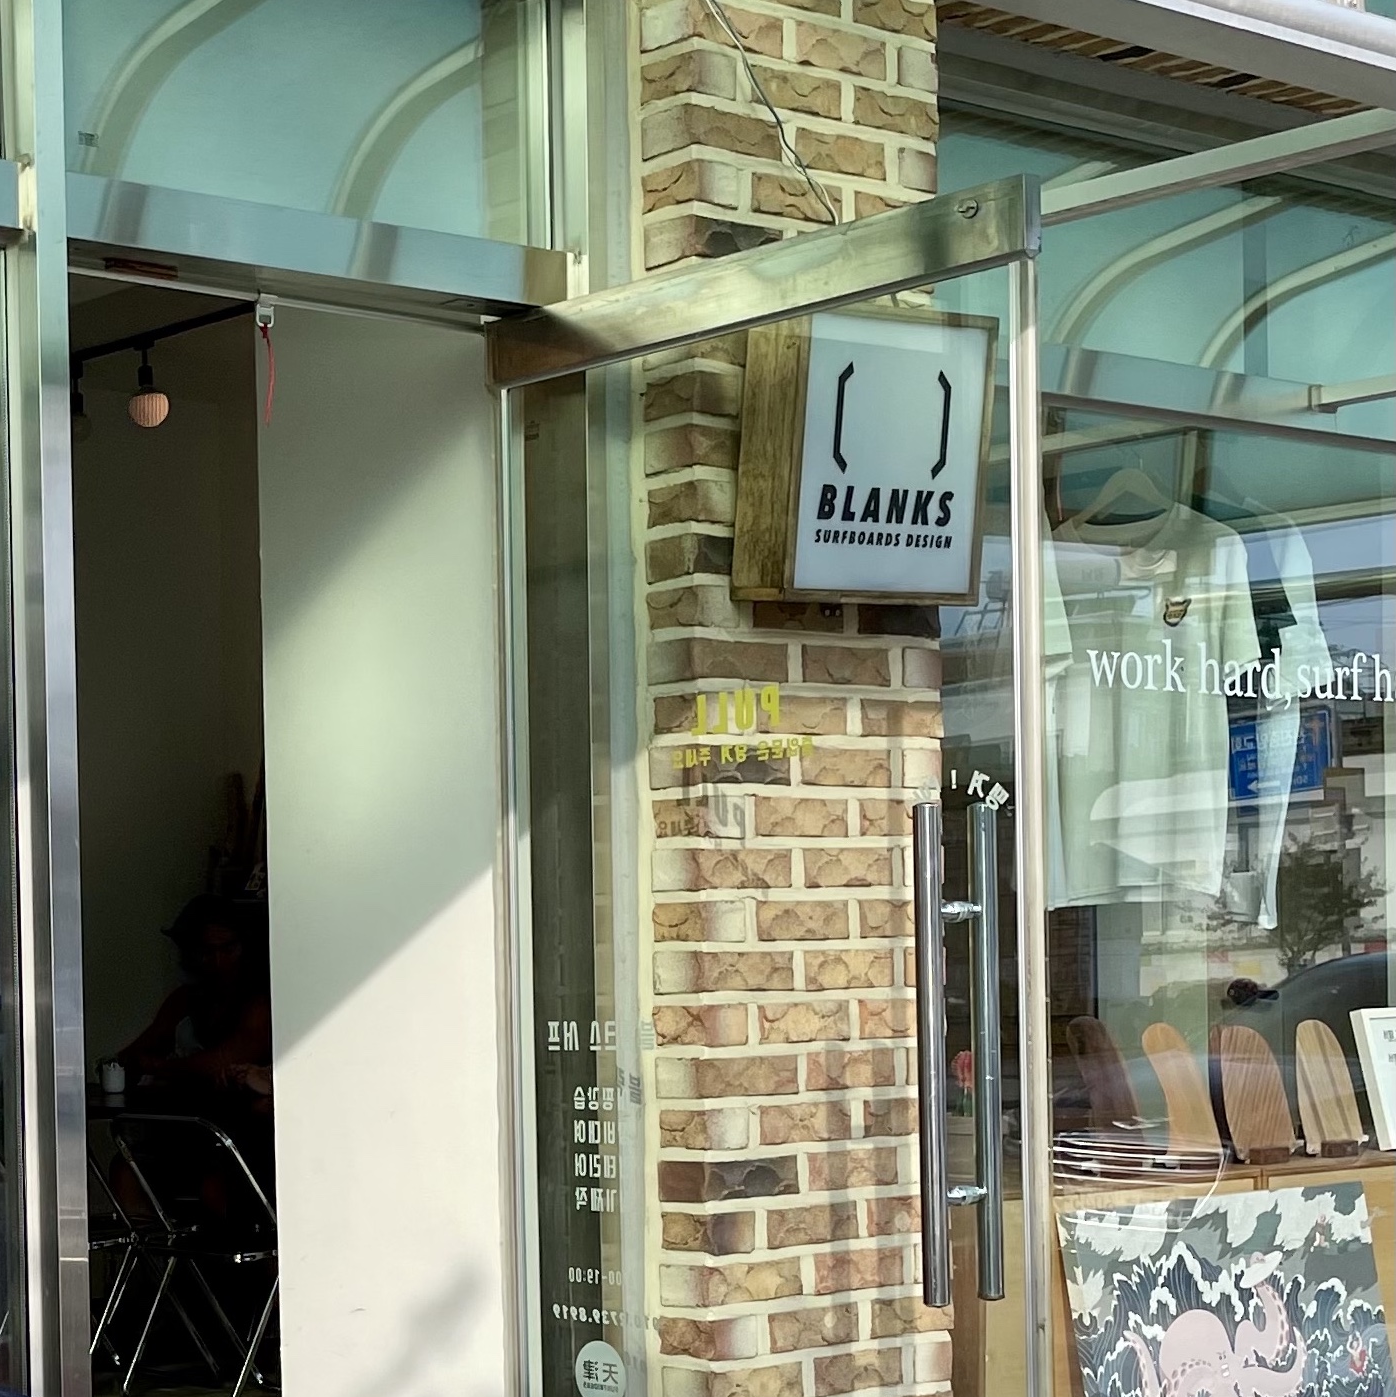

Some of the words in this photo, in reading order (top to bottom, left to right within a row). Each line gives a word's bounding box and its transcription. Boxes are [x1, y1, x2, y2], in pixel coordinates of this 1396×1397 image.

[816, 483, 955, 527] BLANKS
[814, 529, 902, 547] SURFBOARDS
[905, 533, 953, 549] DESIGN
[1086, 639, 1187, 693] work
